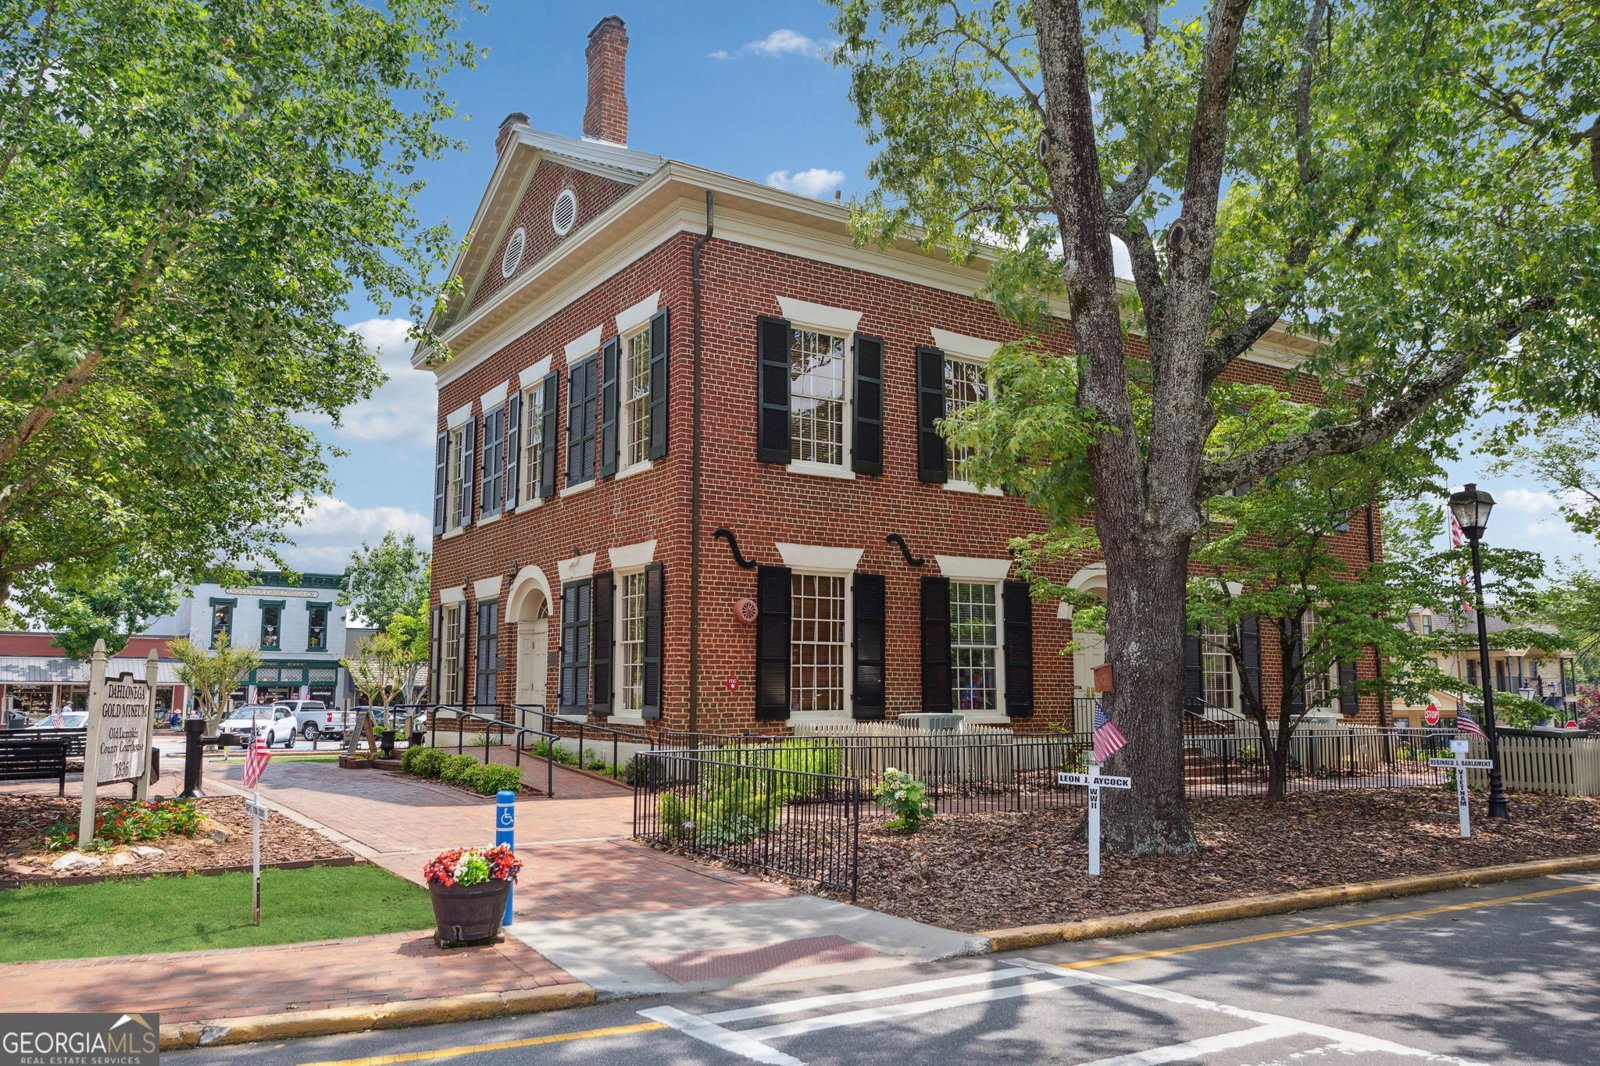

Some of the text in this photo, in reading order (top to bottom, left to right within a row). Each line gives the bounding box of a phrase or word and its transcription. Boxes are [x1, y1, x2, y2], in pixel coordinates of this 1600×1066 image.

[108, 684, 145, 700] DAHLONEGA
[102, 703, 148, 718] GOLD MUSEUM
[1425, 710, 1438, 719] STOP
[109, 727, 138, 741] Old Lumpkin
[100, 740, 144, 755] County Courthouse
[114, 761, 129, 778] 1836
[1060, 774, 1080, 783] LEON
[1094, 777, 1129, 786] AYCOCK
[1458, 769, 1467, 806] VIETNAM
